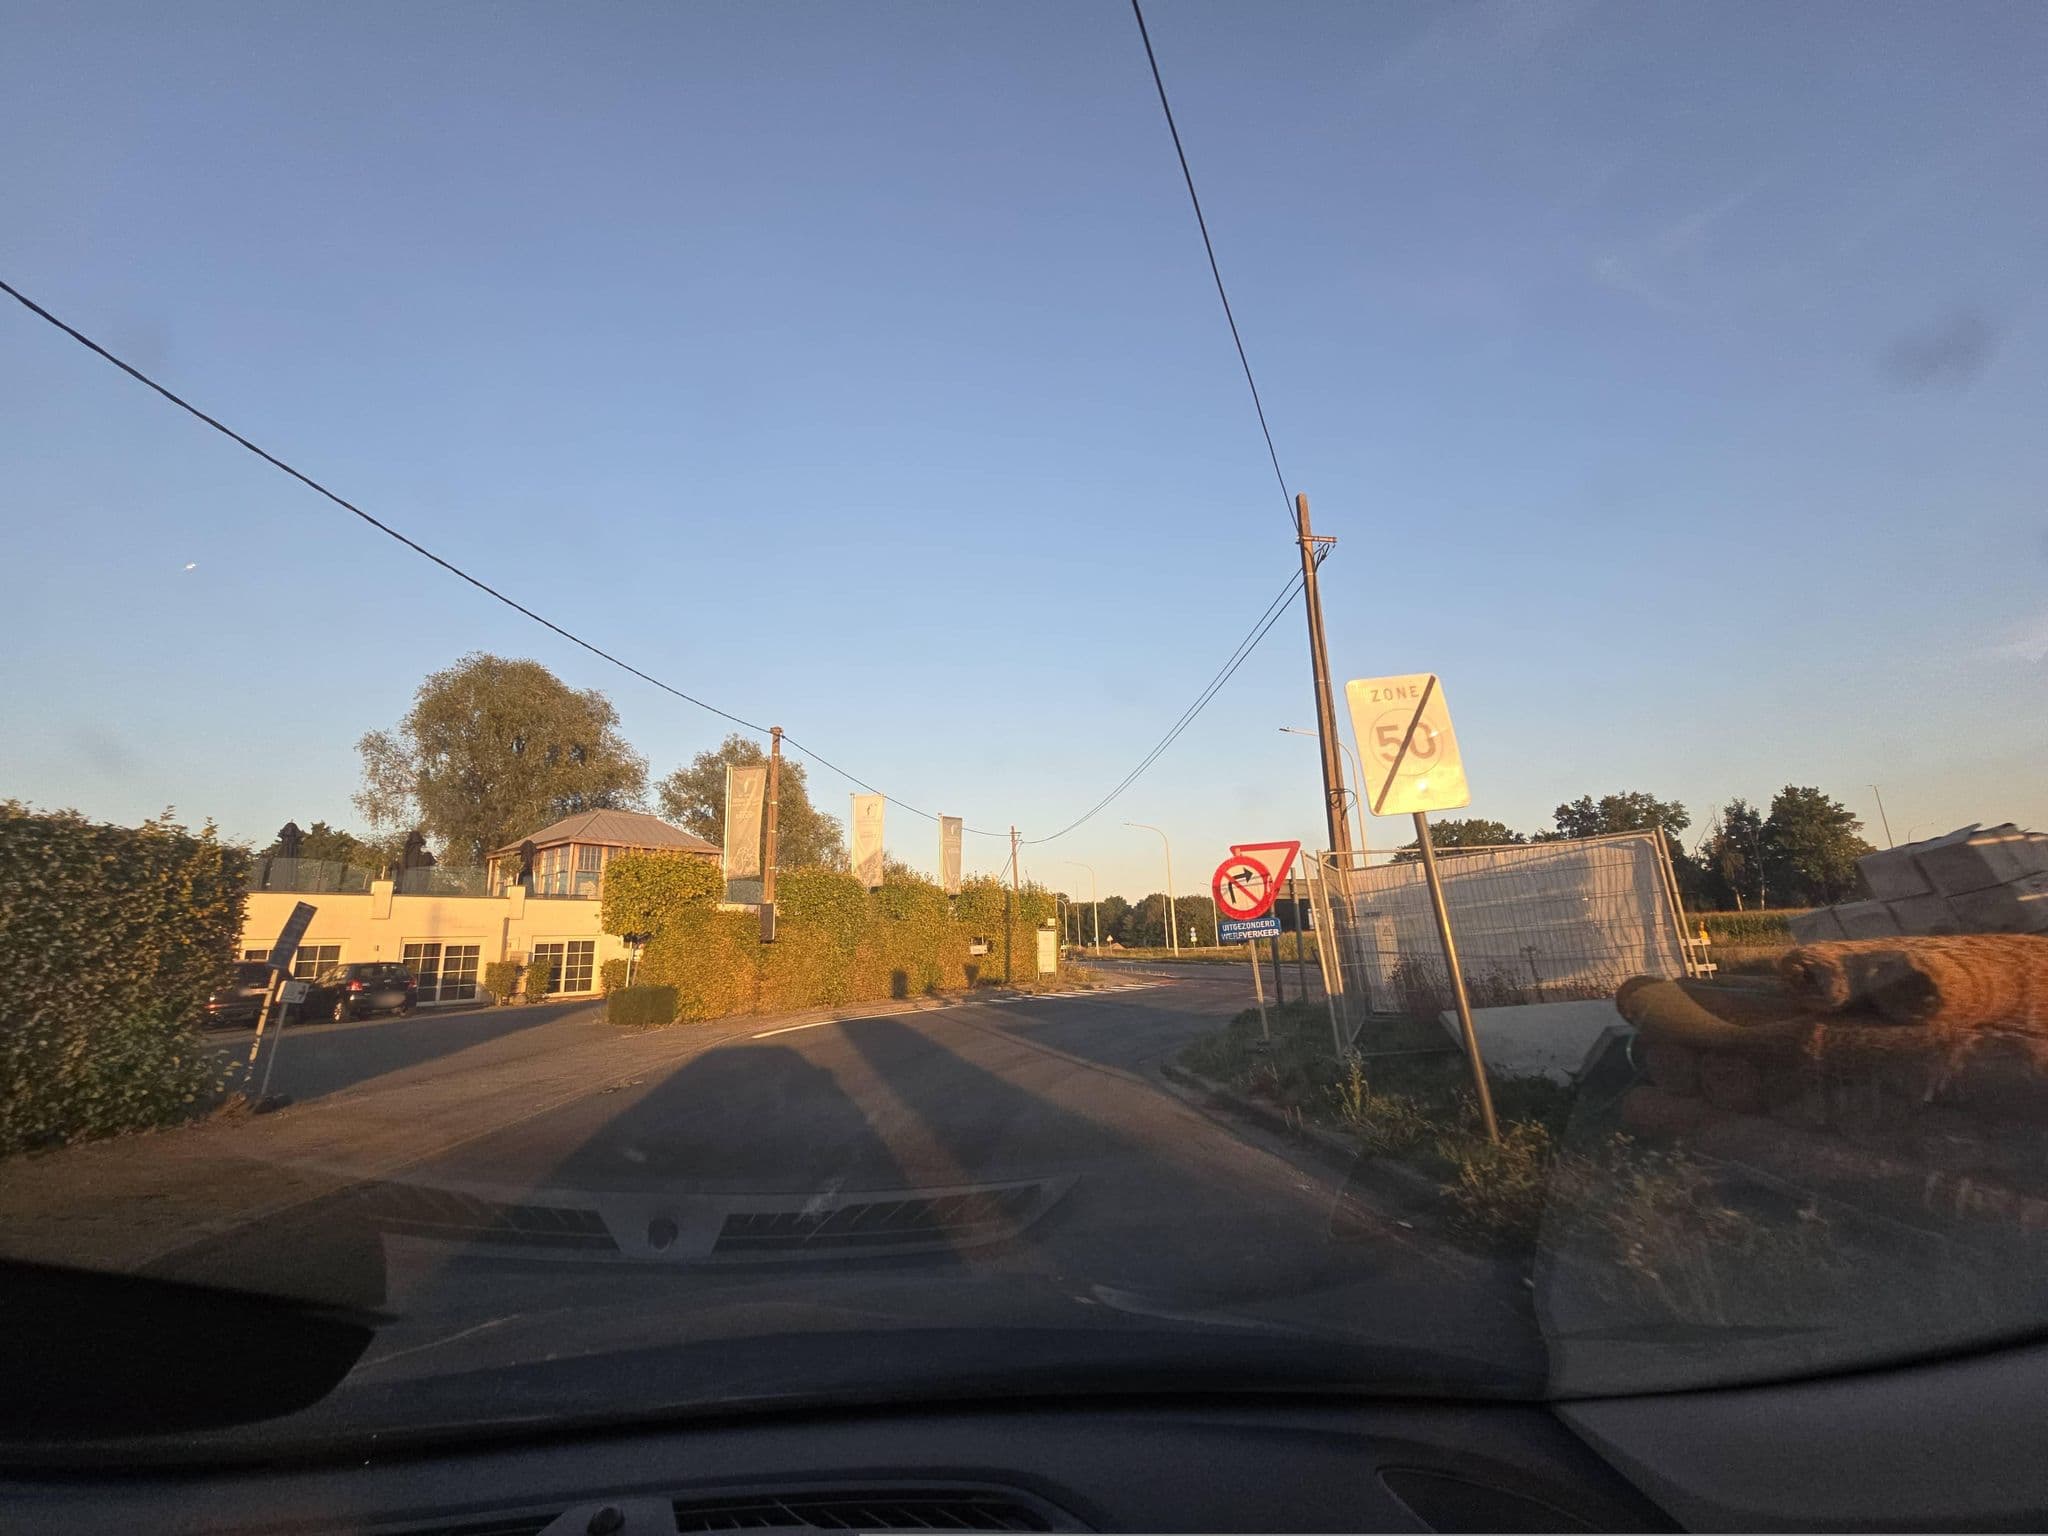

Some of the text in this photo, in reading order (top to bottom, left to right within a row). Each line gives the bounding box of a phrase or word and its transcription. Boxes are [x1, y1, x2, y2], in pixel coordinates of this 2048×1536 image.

[1371, 685, 1419, 702] ZONE
[1376, 722, 1436, 762] 50
[1222, 919, 1275, 931] UITGEZONDERD
[1221, 928, 1279, 940] WERFVERKEER
